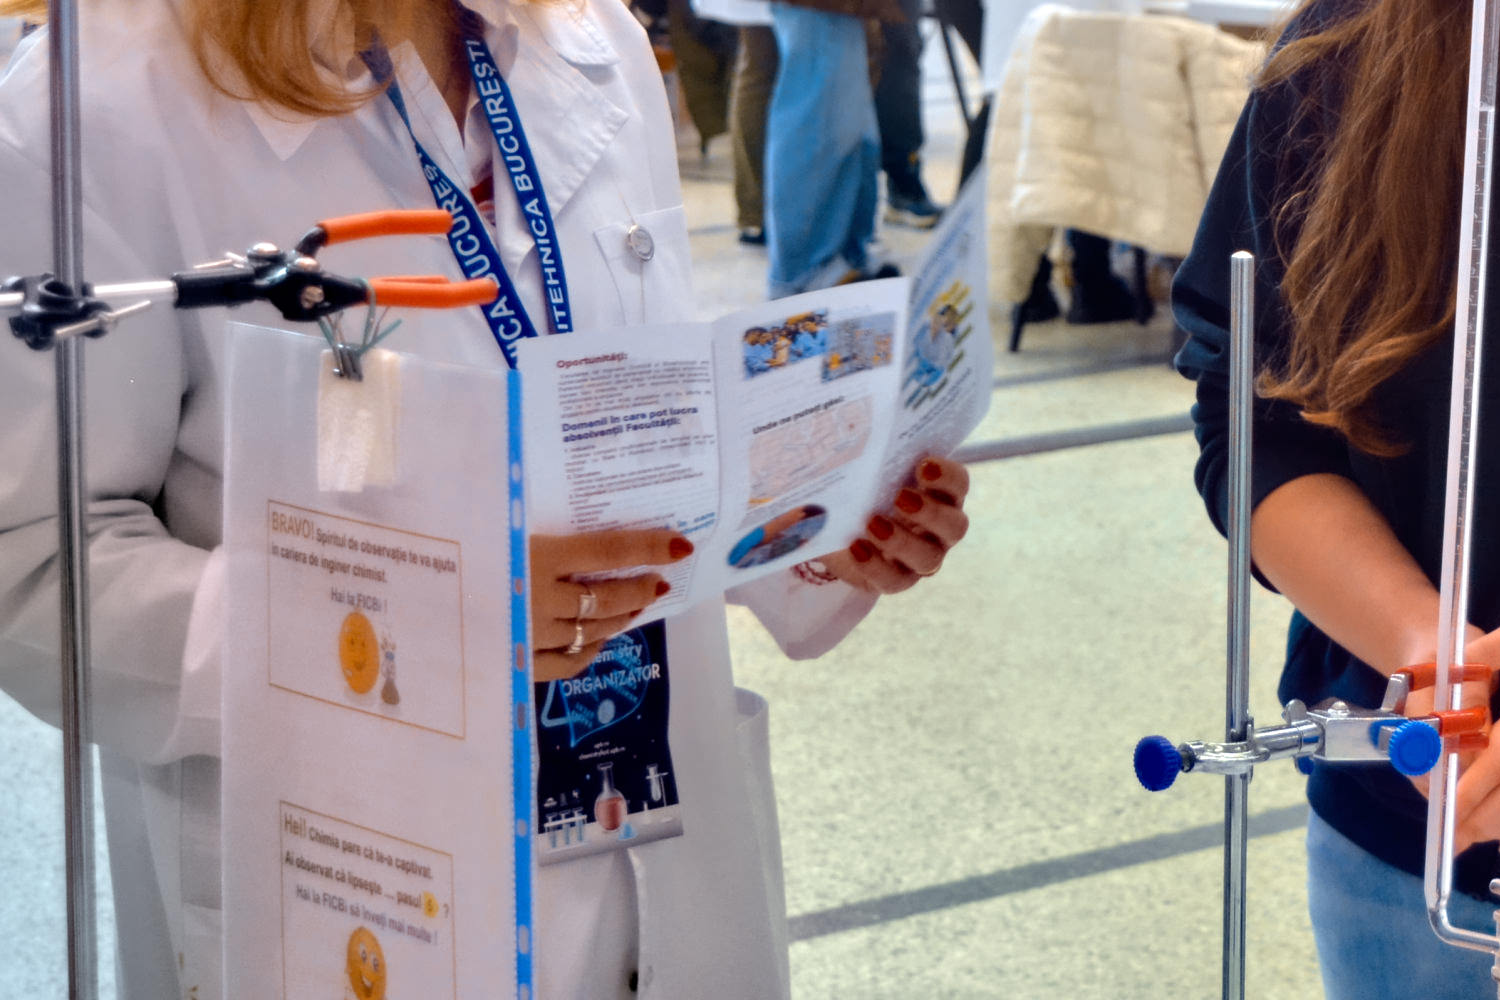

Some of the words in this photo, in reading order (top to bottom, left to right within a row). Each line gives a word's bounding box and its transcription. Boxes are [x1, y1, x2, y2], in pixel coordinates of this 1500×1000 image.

[466, 40, 534, 191] BUCUREȘTI
[525, 198, 569, 330] ITEHNICA
[561, 418, 608, 432] Domenii
[622, 412, 647, 422] care
[649, 409, 668, 420] pot
[272, 511, 315, 539] BRAVO!
[348, 537, 358, 550] de
[409, 551, 417, 564] te
[420, 556, 431, 567] va
[432, 556, 456, 573] ajuta
[309, 554, 319, 566] de
[321, 556, 350, 574] inginer
[347, 591, 355, 605] la
[563, 663, 660, 697] ORGANIZATOR
[309, 827, 339, 849] Chimia
[342, 838, 361, 856] pare
[284, 851, 294, 866] Ai
[295, 854, 333, 879] observat
[296, 884, 311, 901] Hai
[312, 890, 320, 904] la
